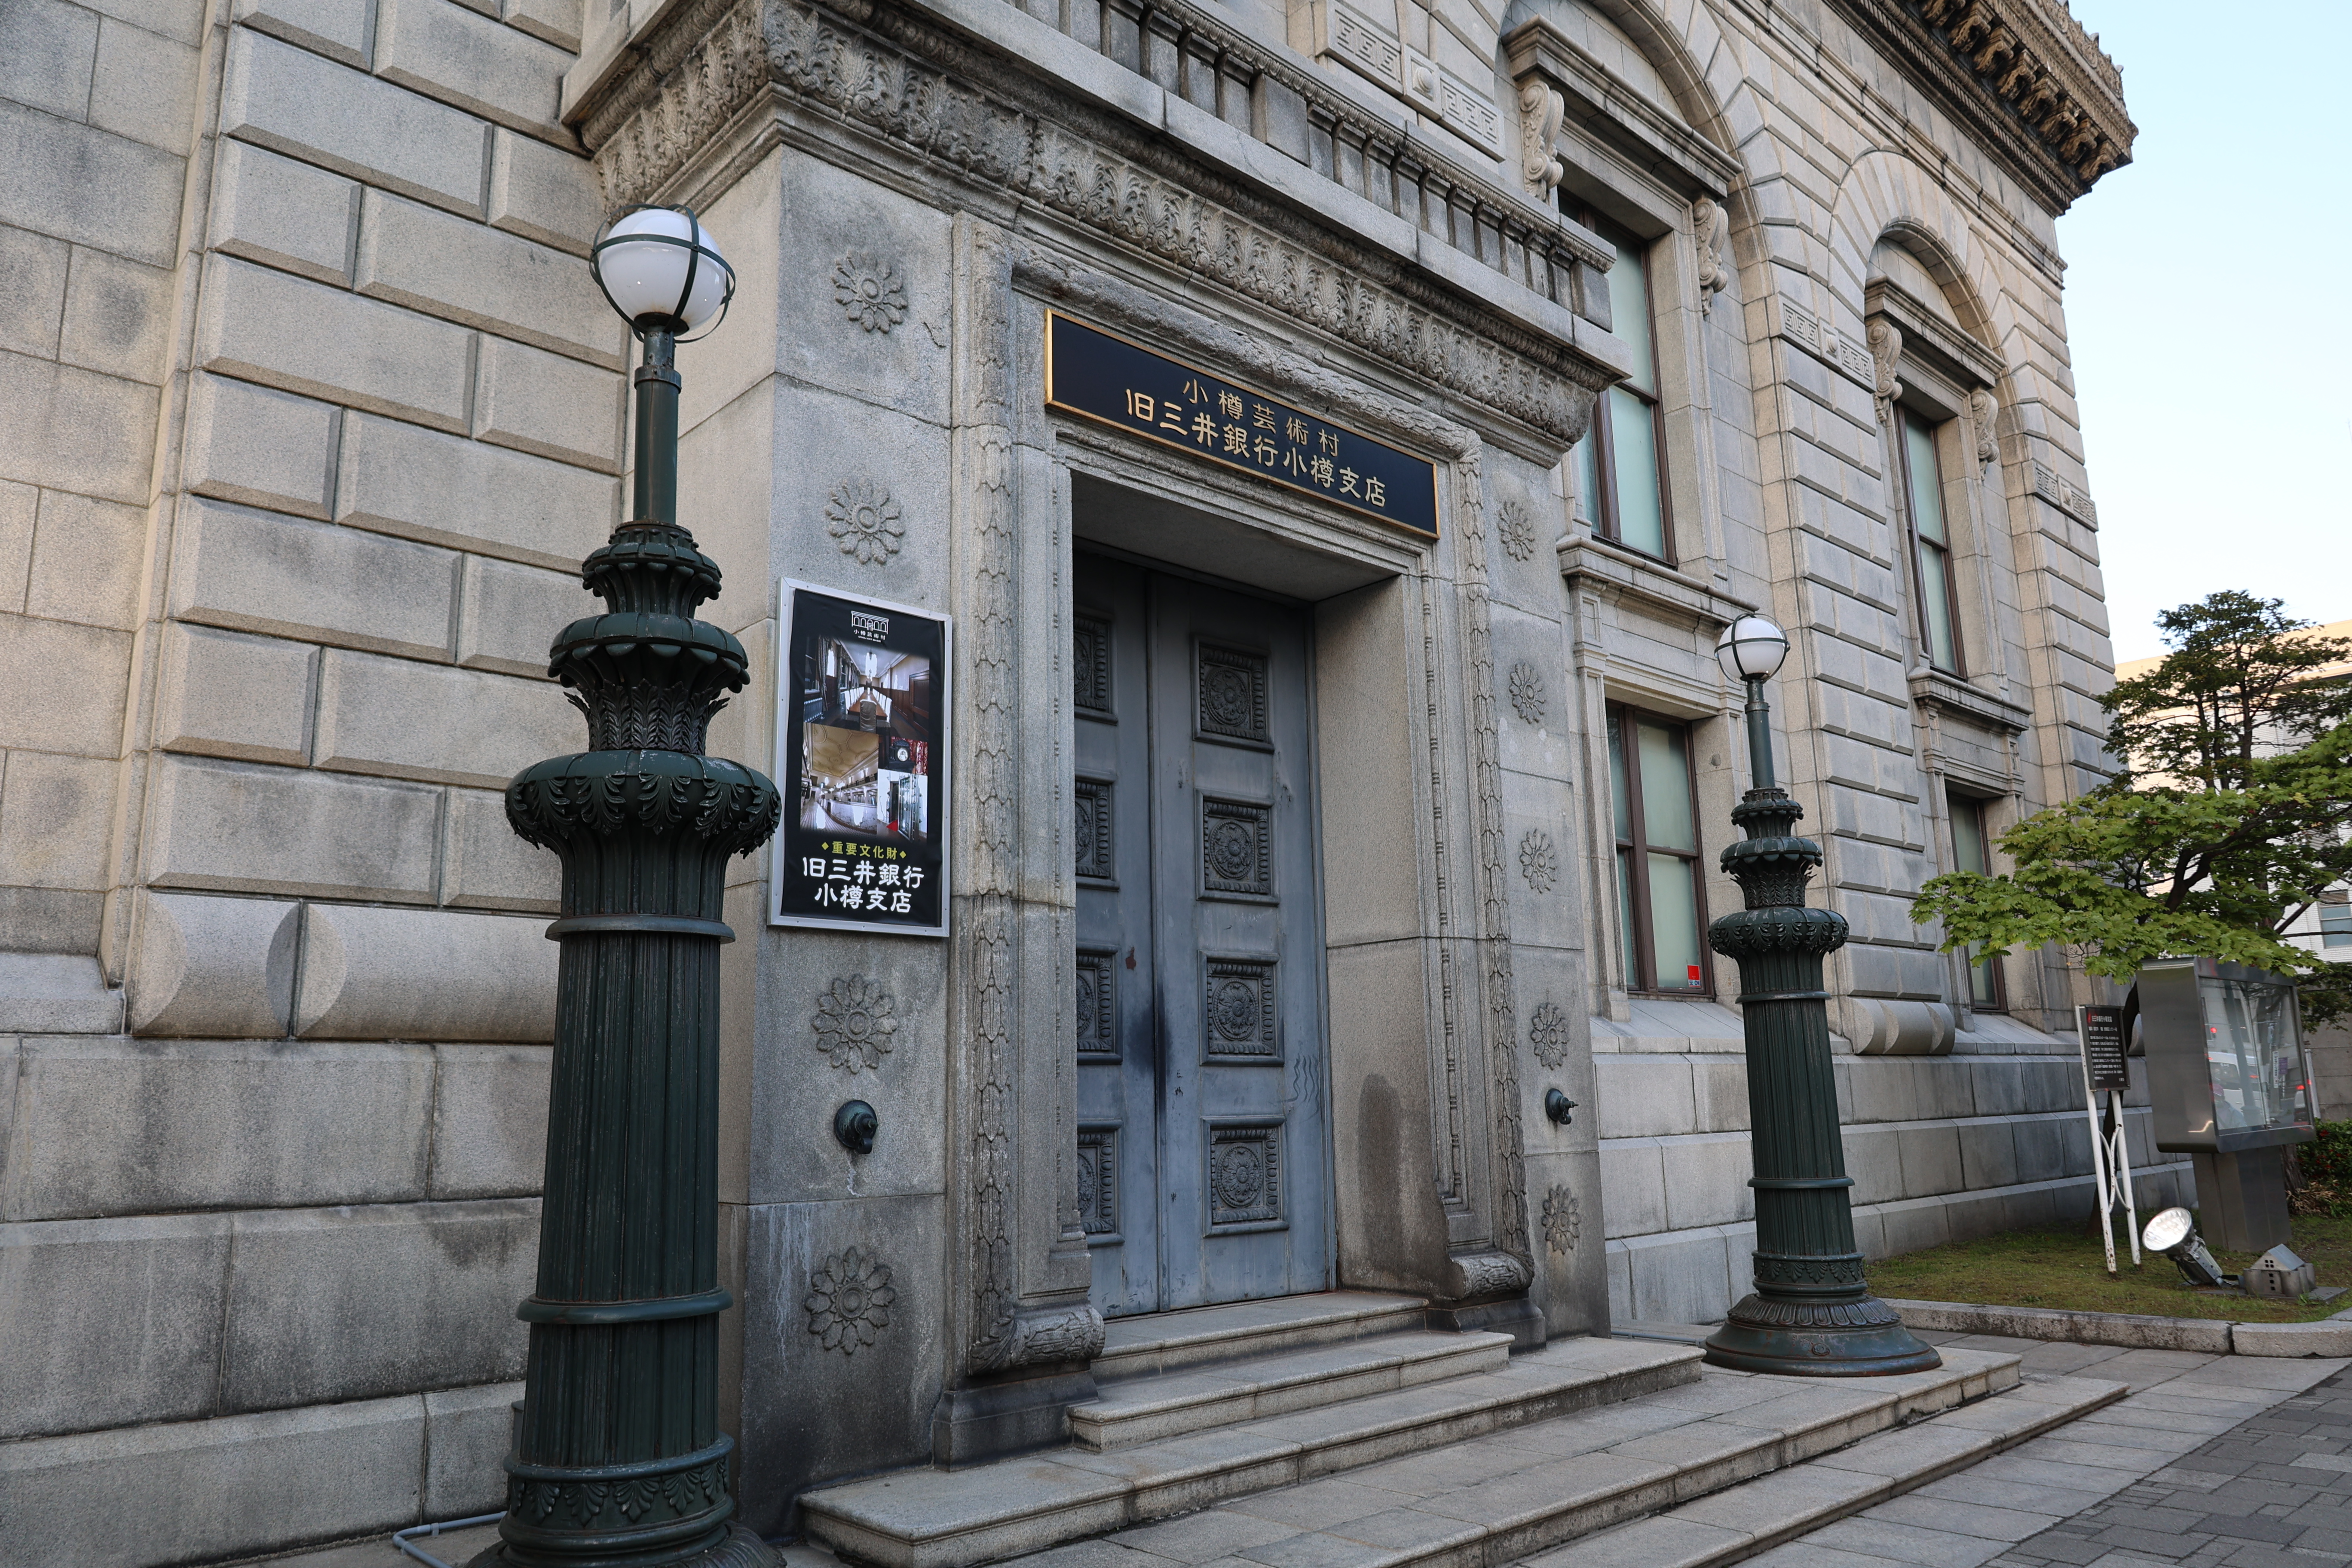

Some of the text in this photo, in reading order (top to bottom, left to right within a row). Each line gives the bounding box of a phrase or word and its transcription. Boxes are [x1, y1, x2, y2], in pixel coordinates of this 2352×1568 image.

[1182, 378, 1339, 457] 小樽芸術村
[1125, 389, 1387, 508] 旧三井銀行小樽支店
[854, 629, 885, 640] 小樽芸術村
[832, 841, 897, 860] 重要文化財
[802, 857, 925, 888] 旧三井銀行
[814, 882, 912, 913] 小樽支店
